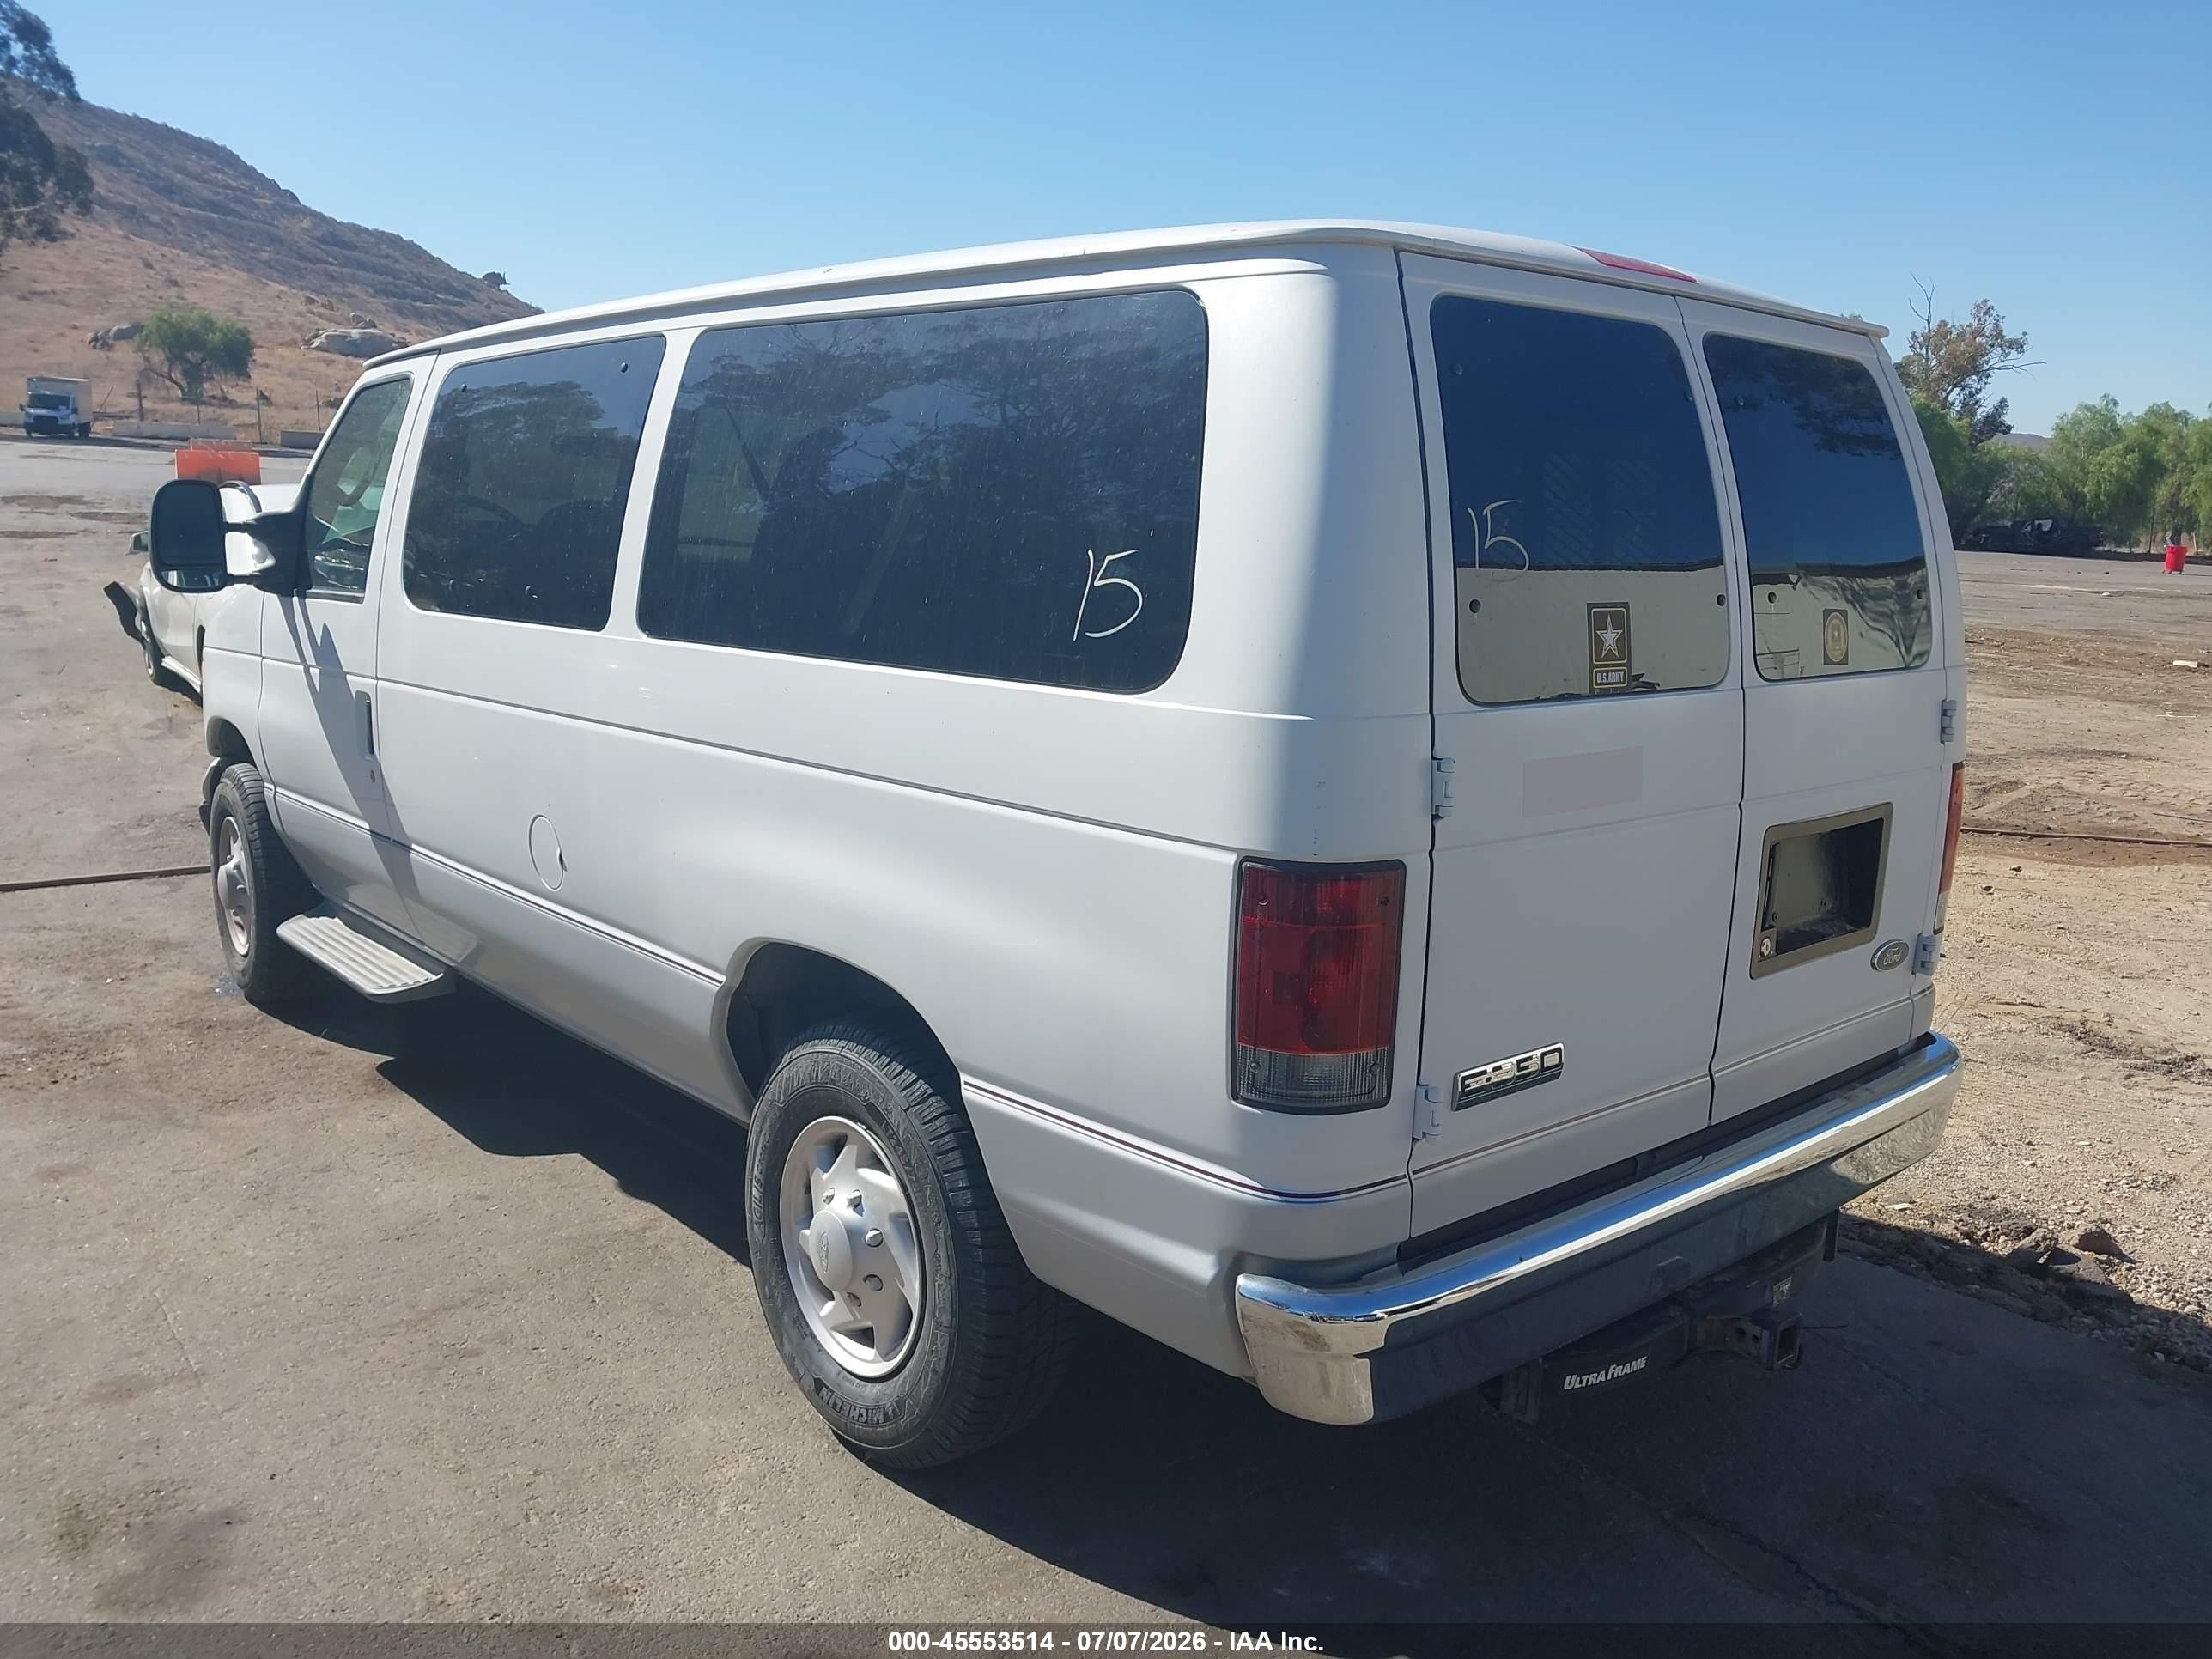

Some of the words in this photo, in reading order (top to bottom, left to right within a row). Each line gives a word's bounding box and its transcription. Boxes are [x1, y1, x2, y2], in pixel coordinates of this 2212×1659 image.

[1467, 500, 1529, 582] 15
[1073, 549, 1143, 641] 15
[1563, 1370, 1606, 1390] ULTRA
[1607, 1356, 1648, 1380] FRAME
[817, 1386, 885, 1425] MICHELIN
